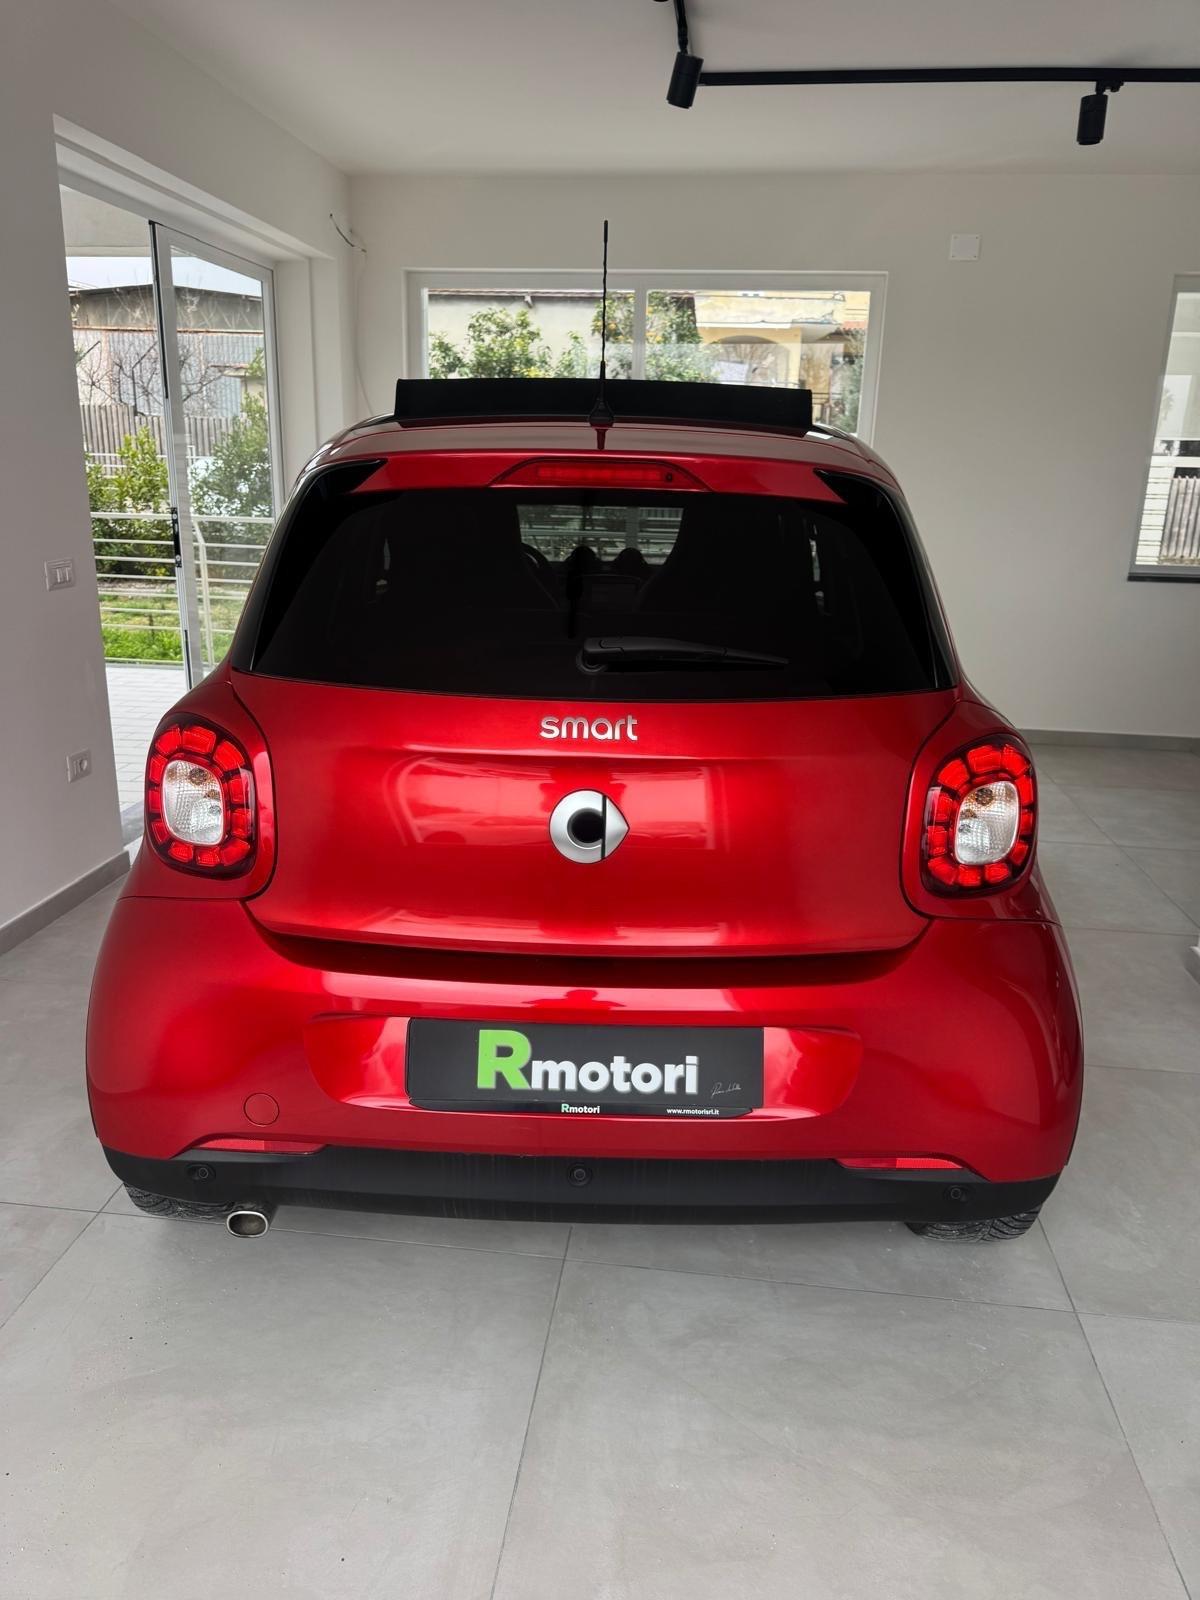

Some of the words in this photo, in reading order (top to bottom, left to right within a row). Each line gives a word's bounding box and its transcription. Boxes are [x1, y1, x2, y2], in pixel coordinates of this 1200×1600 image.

[540, 714, 638, 741] smart
[477, 1029, 698, 1095] Rmotori
[561, 1104, 600, 1114] Rmotori
